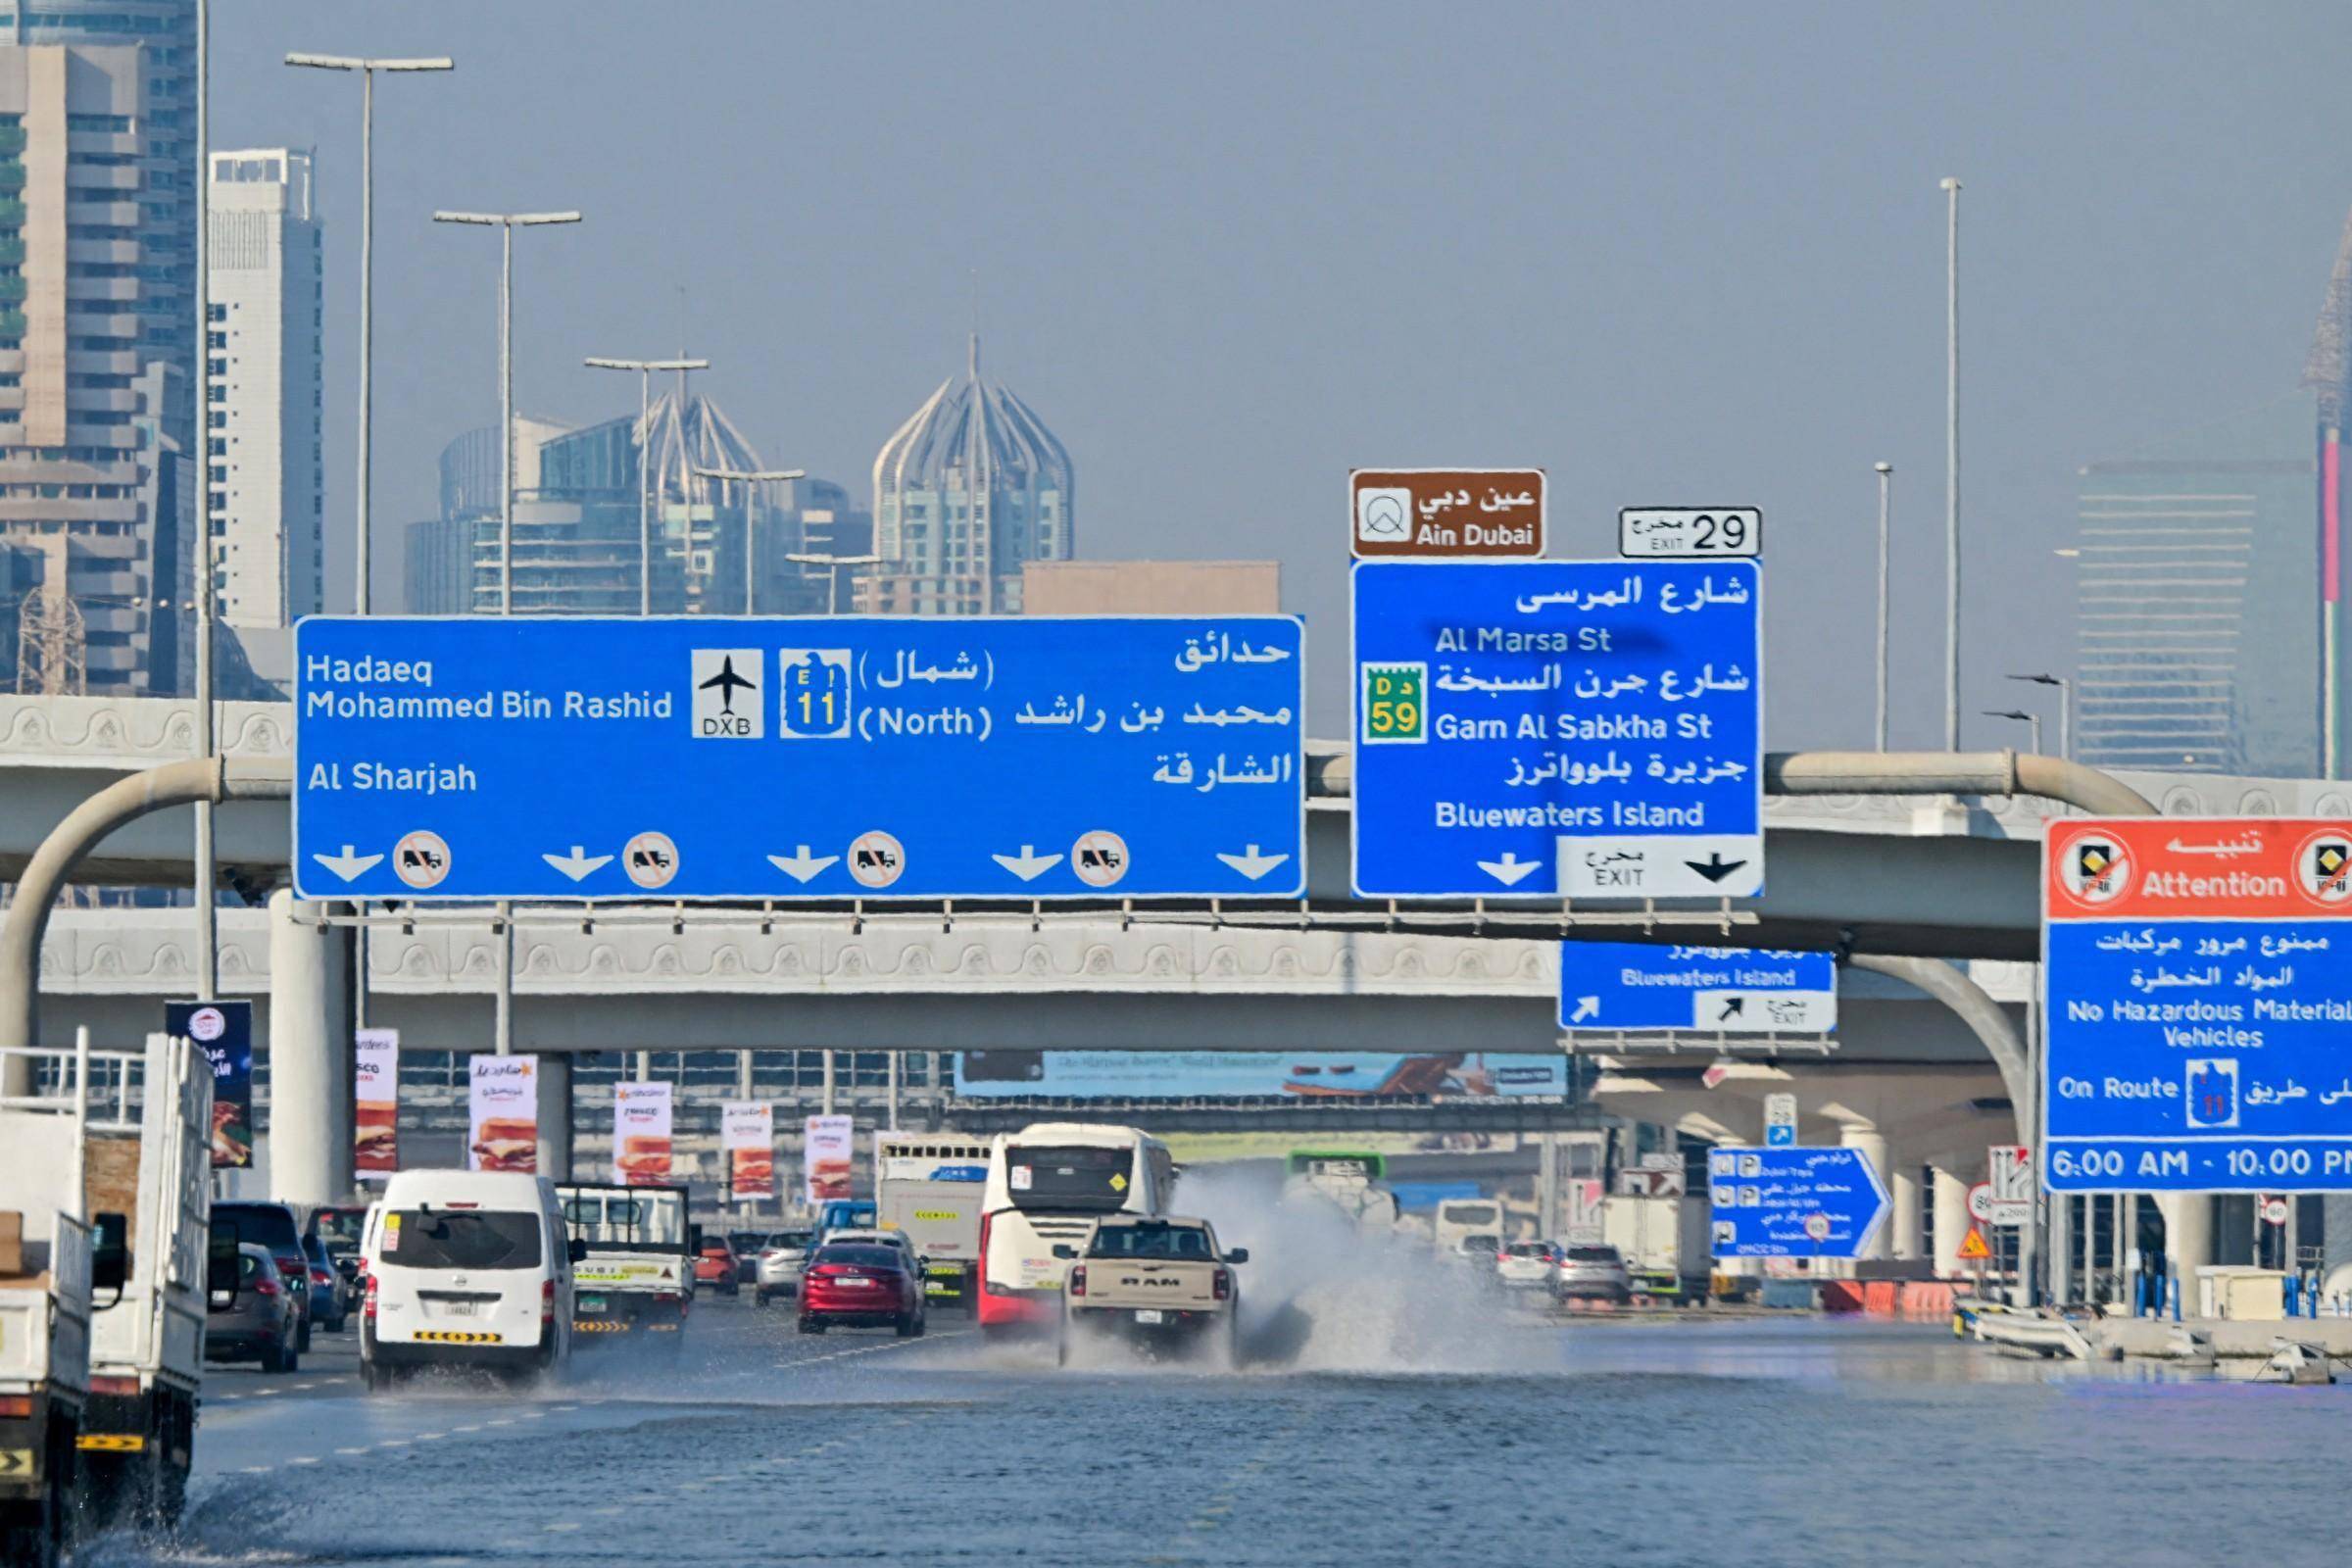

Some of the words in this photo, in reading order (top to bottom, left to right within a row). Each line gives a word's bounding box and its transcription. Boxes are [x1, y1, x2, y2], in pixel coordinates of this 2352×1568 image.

[1417, 489, 1472, 521] دبي
[1479, 487, 1537, 513] عين
[1416, 523, 1457, 547] Ain
[1463, 523, 1535, 547] Dubai
[1632, 519, 1684, 537] مخرج
[1692, 514, 1745, 550] 29
[1651, 537, 1684, 551] EXIT
[1515, 575, 1643, 613] المرسى
[1659, 575, 1750, 613] شارع
[1174, 629, 1292, 673] حدائق
[1435, 627, 1468, 653] Al
[1477, 627, 1568, 653] Marsa
[1578, 626, 1612, 652] St
[307, 655, 432, 687] Hadaeq
[798, 668, 809, 684] E
[1435, 663, 1563, 699] السبخة
[1574, 668, 1649, 699] جرن
[1659, 663, 1750, 702] شارع
[1377, 677, 1392, 695] D
[307, 690, 494, 719] Mohammed
[502, 690, 552, 718] Bin
[564, 690, 672, 719] Rashid
[799, 691, 833, 724] 11
[1015, 694, 1106, 733] راشد
[1119, 702, 1165, 733] بن
[1183, 702, 1292, 727] محمد
[1372, 702, 1418, 732] 59
[703, 717, 751, 736] DXB
[858, 706, 993, 742] (North)
[1435, 713, 1508, 741] Garn
[1516, 712, 1549, 739] Al
[1557, 713, 1668, 741] Sabkha
[1676, 712, 1713, 739] St
[308, 763, 342, 791] Al
[352, 761, 477, 796] Sharjah
[1152, 751, 1293, 794] الشارقة
[1504, 751, 1634, 787] بلوواترز
[1646, 752, 1749, 785] جزيرة
[1435, 802, 1604, 828] Bluewaters
[1613, 801, 1705, 827] Island
[2165, 828, 2264, 859] تنبيه
[1586, 851, 1644, 868] مخرج
[1594, 868, 1644, 886] EXIT
[2140, 870, 2287, 898] Attention
[2095, 928, 2182, 956] مركبات
[2194, 937, 2247, 956] مرور
[2259, 932, 2330, 957] ممنوع
[1621, 967, 1731, 987] Bluewaters
[1735, 967, 1797, 987] Island
[2131, 966, 2222, 994] الخطرة
[2233, 964, 2294, 993] المواد
[2068, 1000, 2104, 1022] No
[2112, 999, 2244, 1022] Hazardous
[2163, 1025, 2264, 1049] Vehicles
[2058, 1076, 2094, 1099] On
[2104, 1076, 2180, 1099] Route
[2244, 1077, 2309, 1105] طريق
[2204, 1095, 2223, 1115] 11
[2052, 1149, 2125, 1178] 6:00
[2137, 1150, 2189, 1177] AM
[2227, 1148, 2311, 1177] 10:00
[1120, 1277, 1181, 1287] RAM
